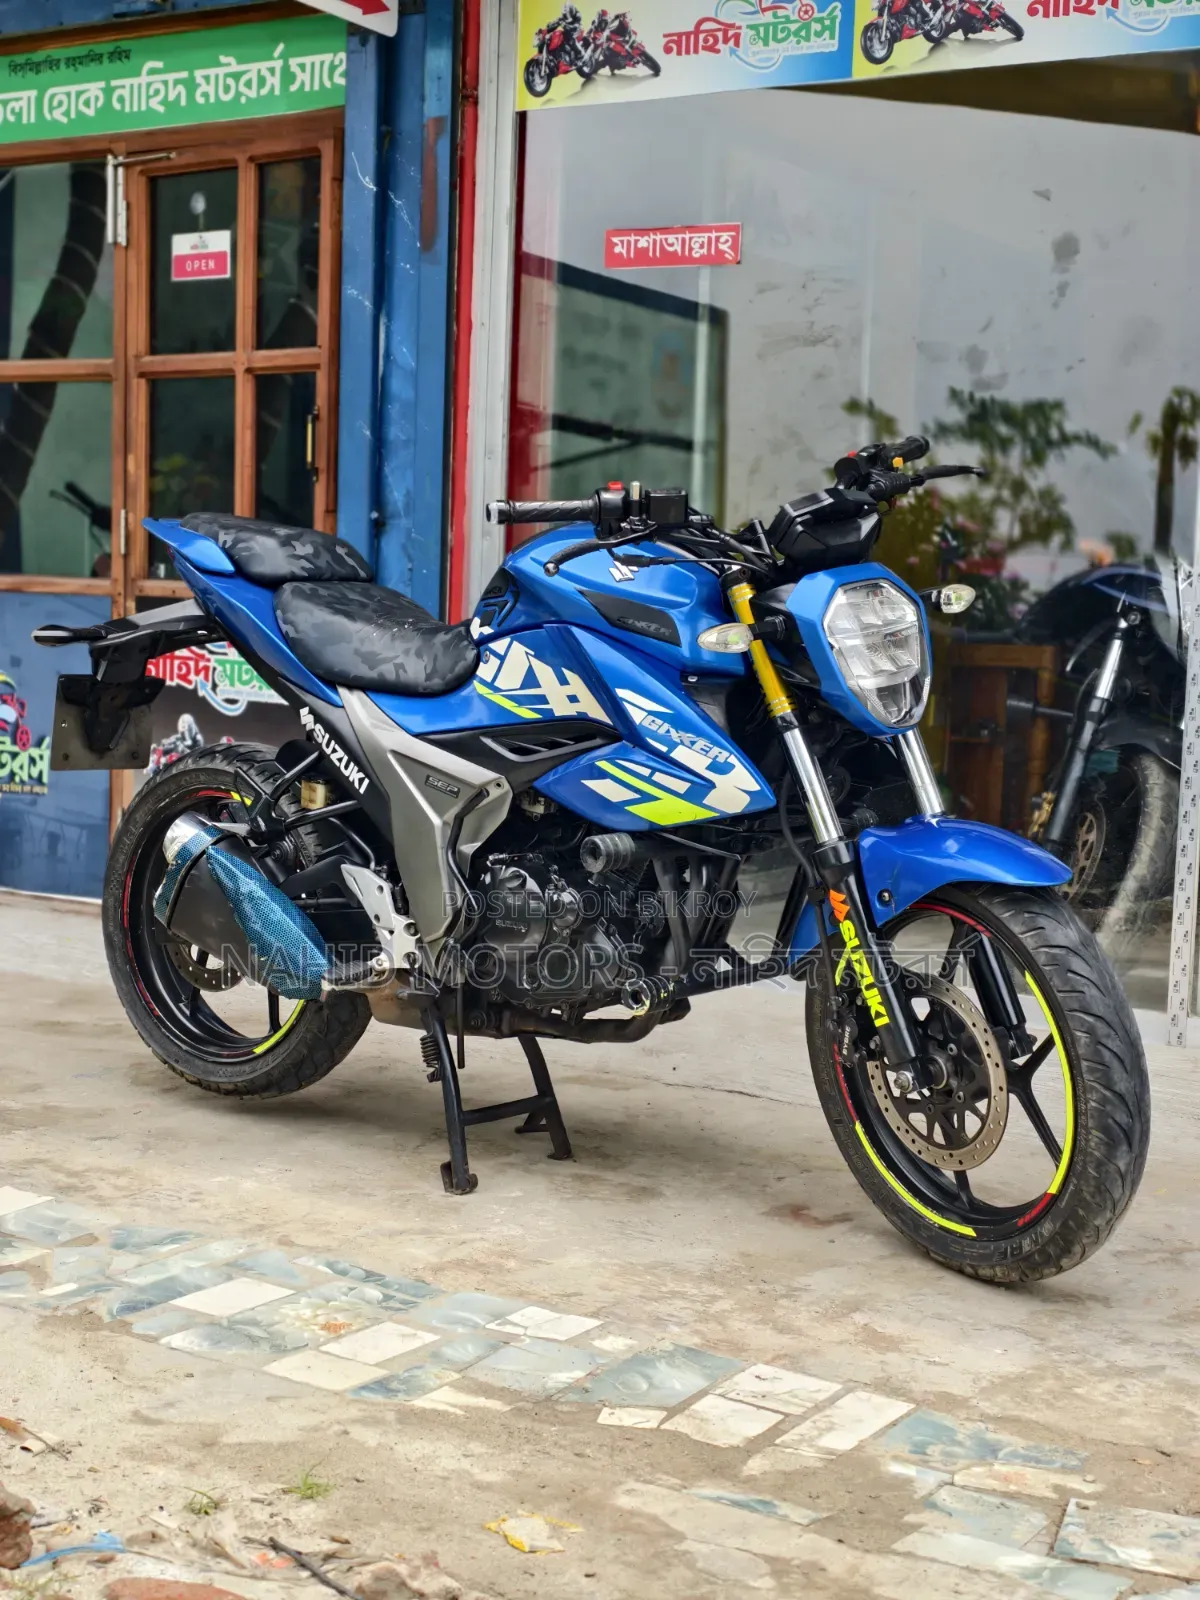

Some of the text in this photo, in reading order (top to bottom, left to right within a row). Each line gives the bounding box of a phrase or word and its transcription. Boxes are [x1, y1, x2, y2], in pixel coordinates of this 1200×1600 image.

[662, 16, 742, 56] নাহিদ
[0, 89, 38, 126] লা
[43, 81, 106, 124] হোক
[110, 61, 189, 114] নাহিদ
[186, 259, 215, 272] OPEN
[313, 723, 370, 795] SUZUKI
[641, 714, 730, 763] GIXXER
[427, 776, 459, 792] SEP
[840, 919, 890, 1028] SUZUKI
[842, 1026, 851, 1055] BYBRE
